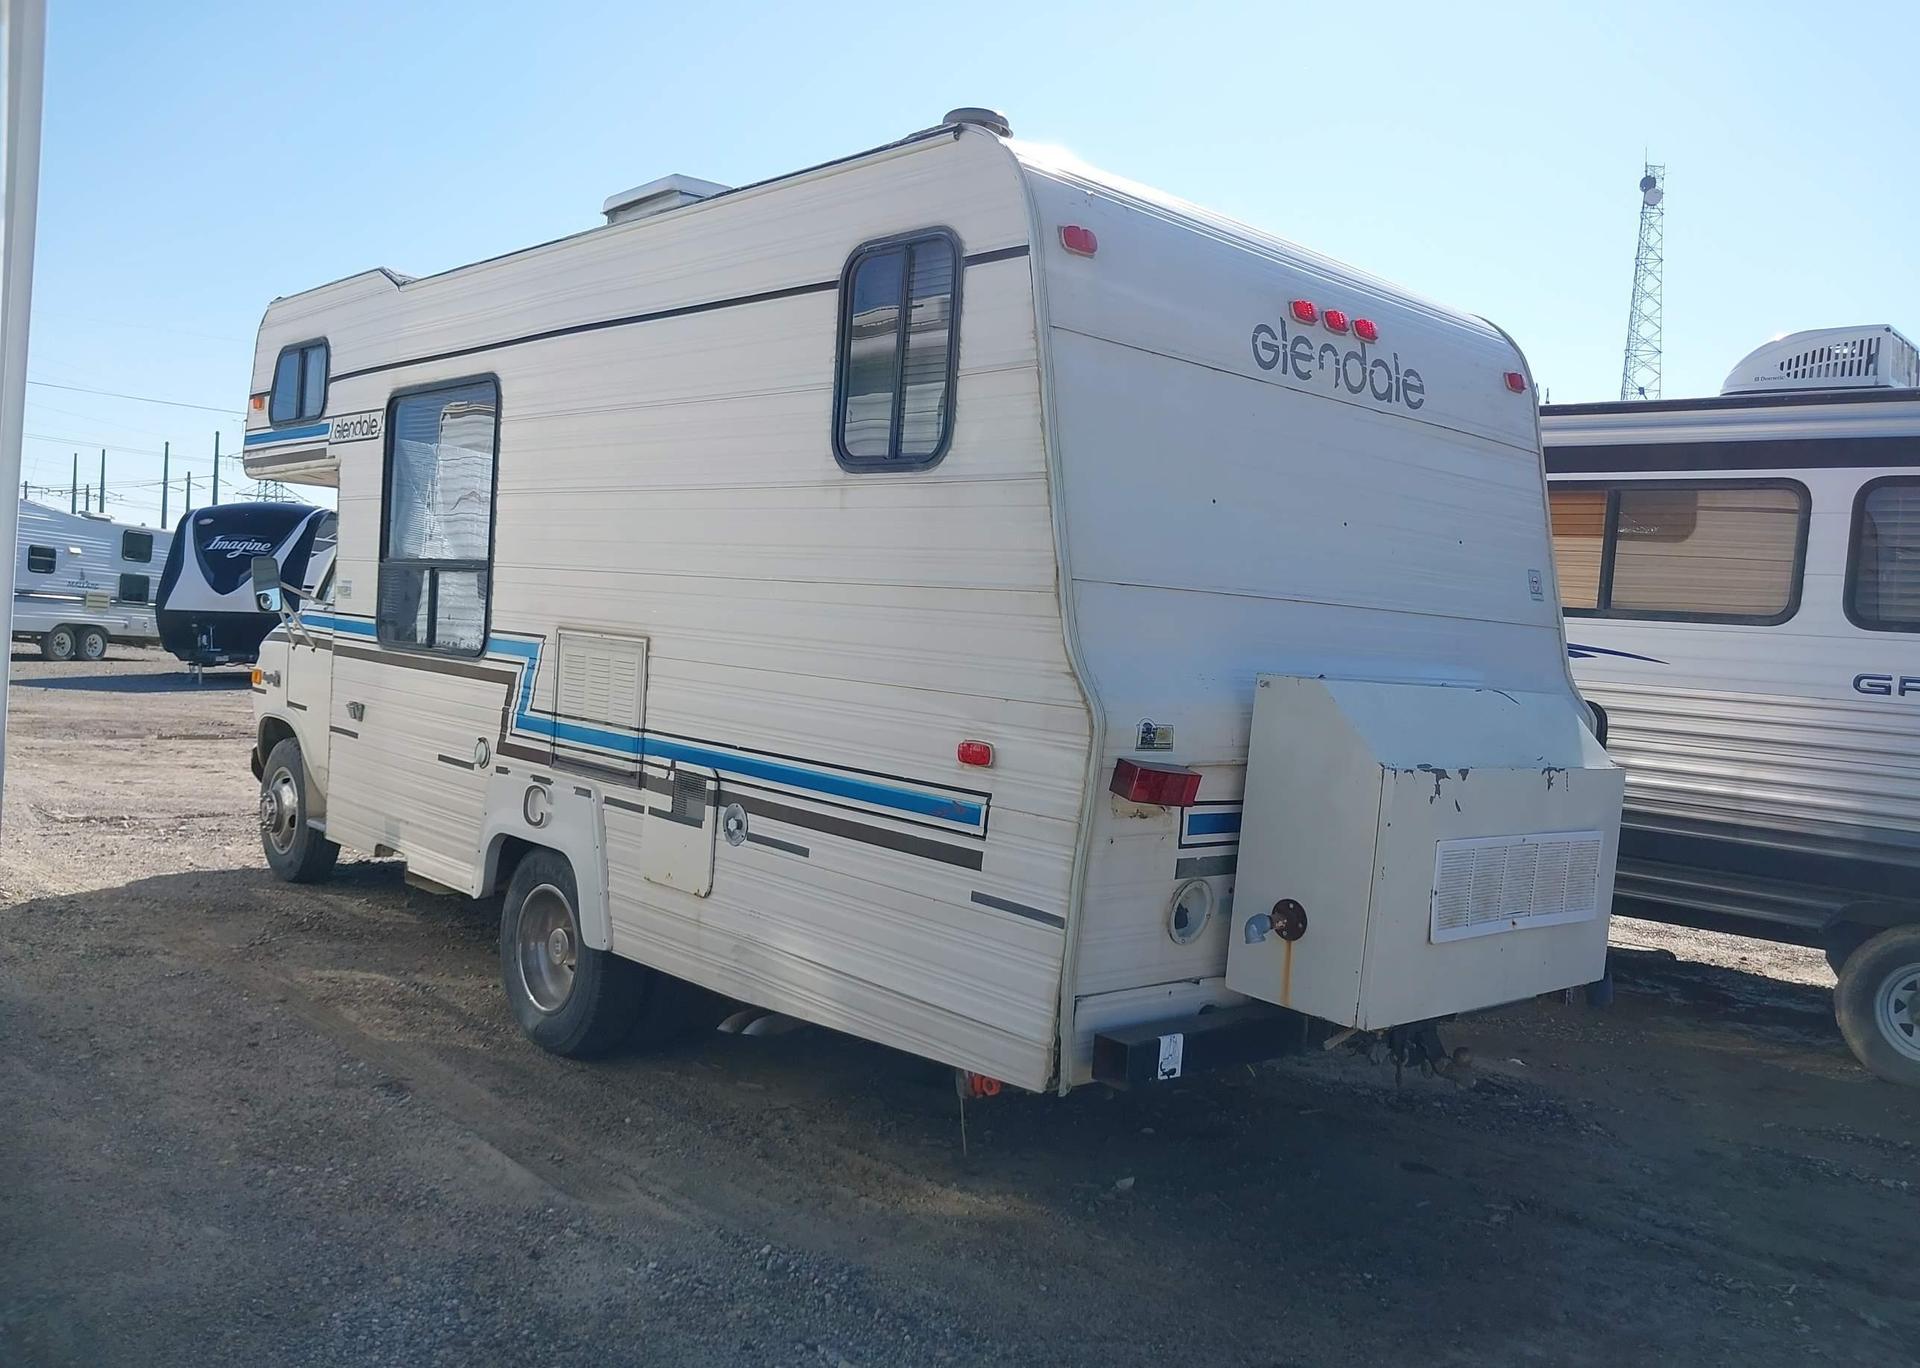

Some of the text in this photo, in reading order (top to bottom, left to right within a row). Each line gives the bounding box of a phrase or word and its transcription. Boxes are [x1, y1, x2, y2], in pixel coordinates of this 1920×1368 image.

[1252, 317, 1425, 410] Glendale
[334, 413, 378, 439] Glendale
[206, 535, 273, 558] Imagine
